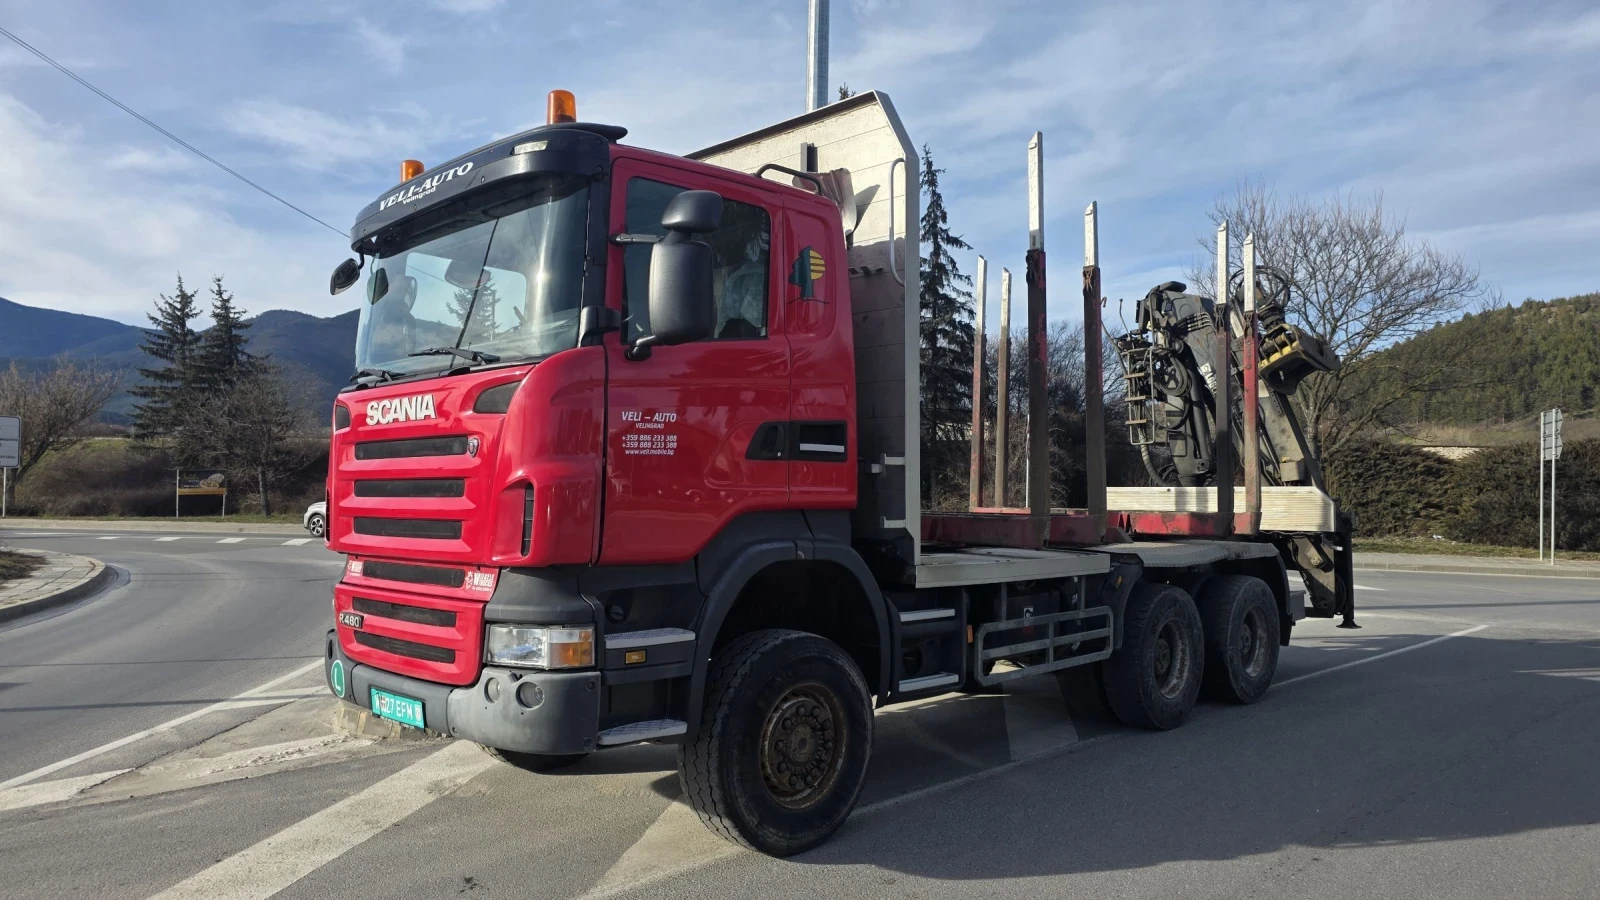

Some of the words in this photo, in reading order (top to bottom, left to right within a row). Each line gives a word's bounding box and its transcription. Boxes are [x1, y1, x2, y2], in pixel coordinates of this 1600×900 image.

[380, 162, 474, 212] VELI-AUTO
[402, 186, 436, 205] Velingrad
[366, 394, 436, 426] SCANIA
[622, 411, 642, 421] VELI
[652, 412, 676, 422] AUTO
[334, 667, 342, 692] L
